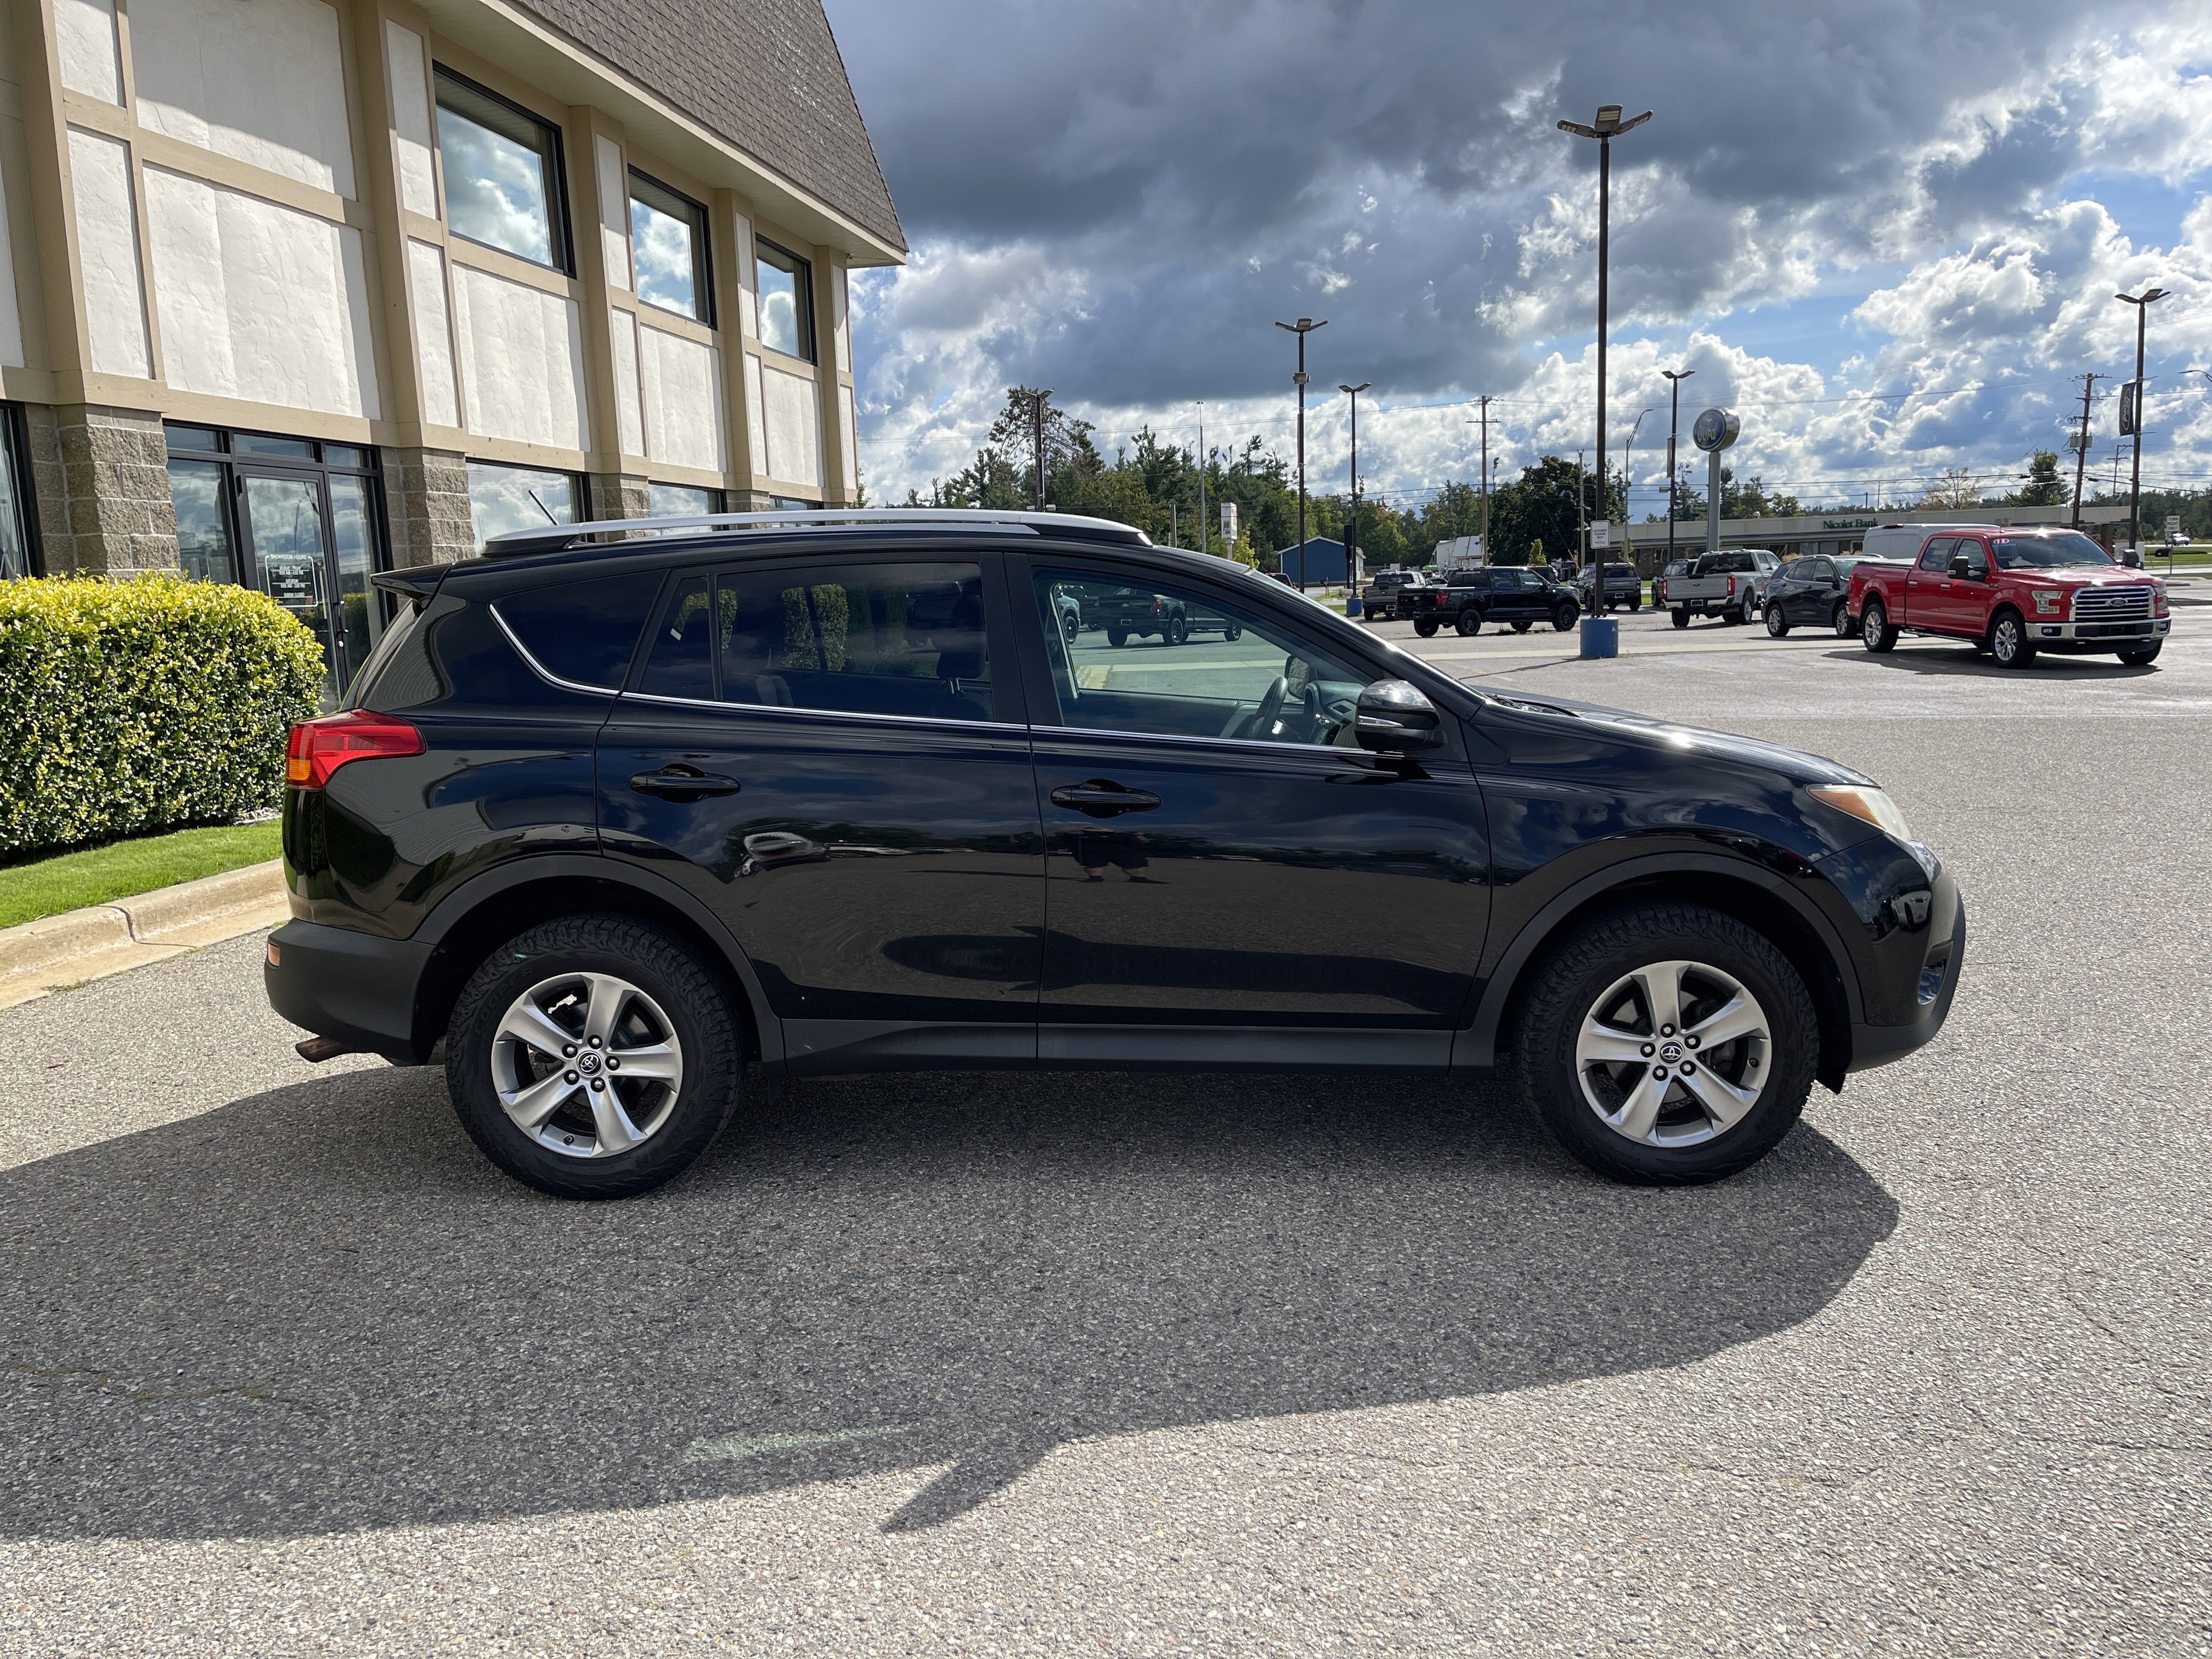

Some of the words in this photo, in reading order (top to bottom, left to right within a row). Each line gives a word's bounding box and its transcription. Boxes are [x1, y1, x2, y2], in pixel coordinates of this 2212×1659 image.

[1697, 417, 1718, 443] Ford
[1823, 520, 1853, 529] Nicolet
[1855, 518, 1879, 527] Bank
[475, 967, 533, 1034] COOPER
[1559, 981, 1595, 1064] COOPER
